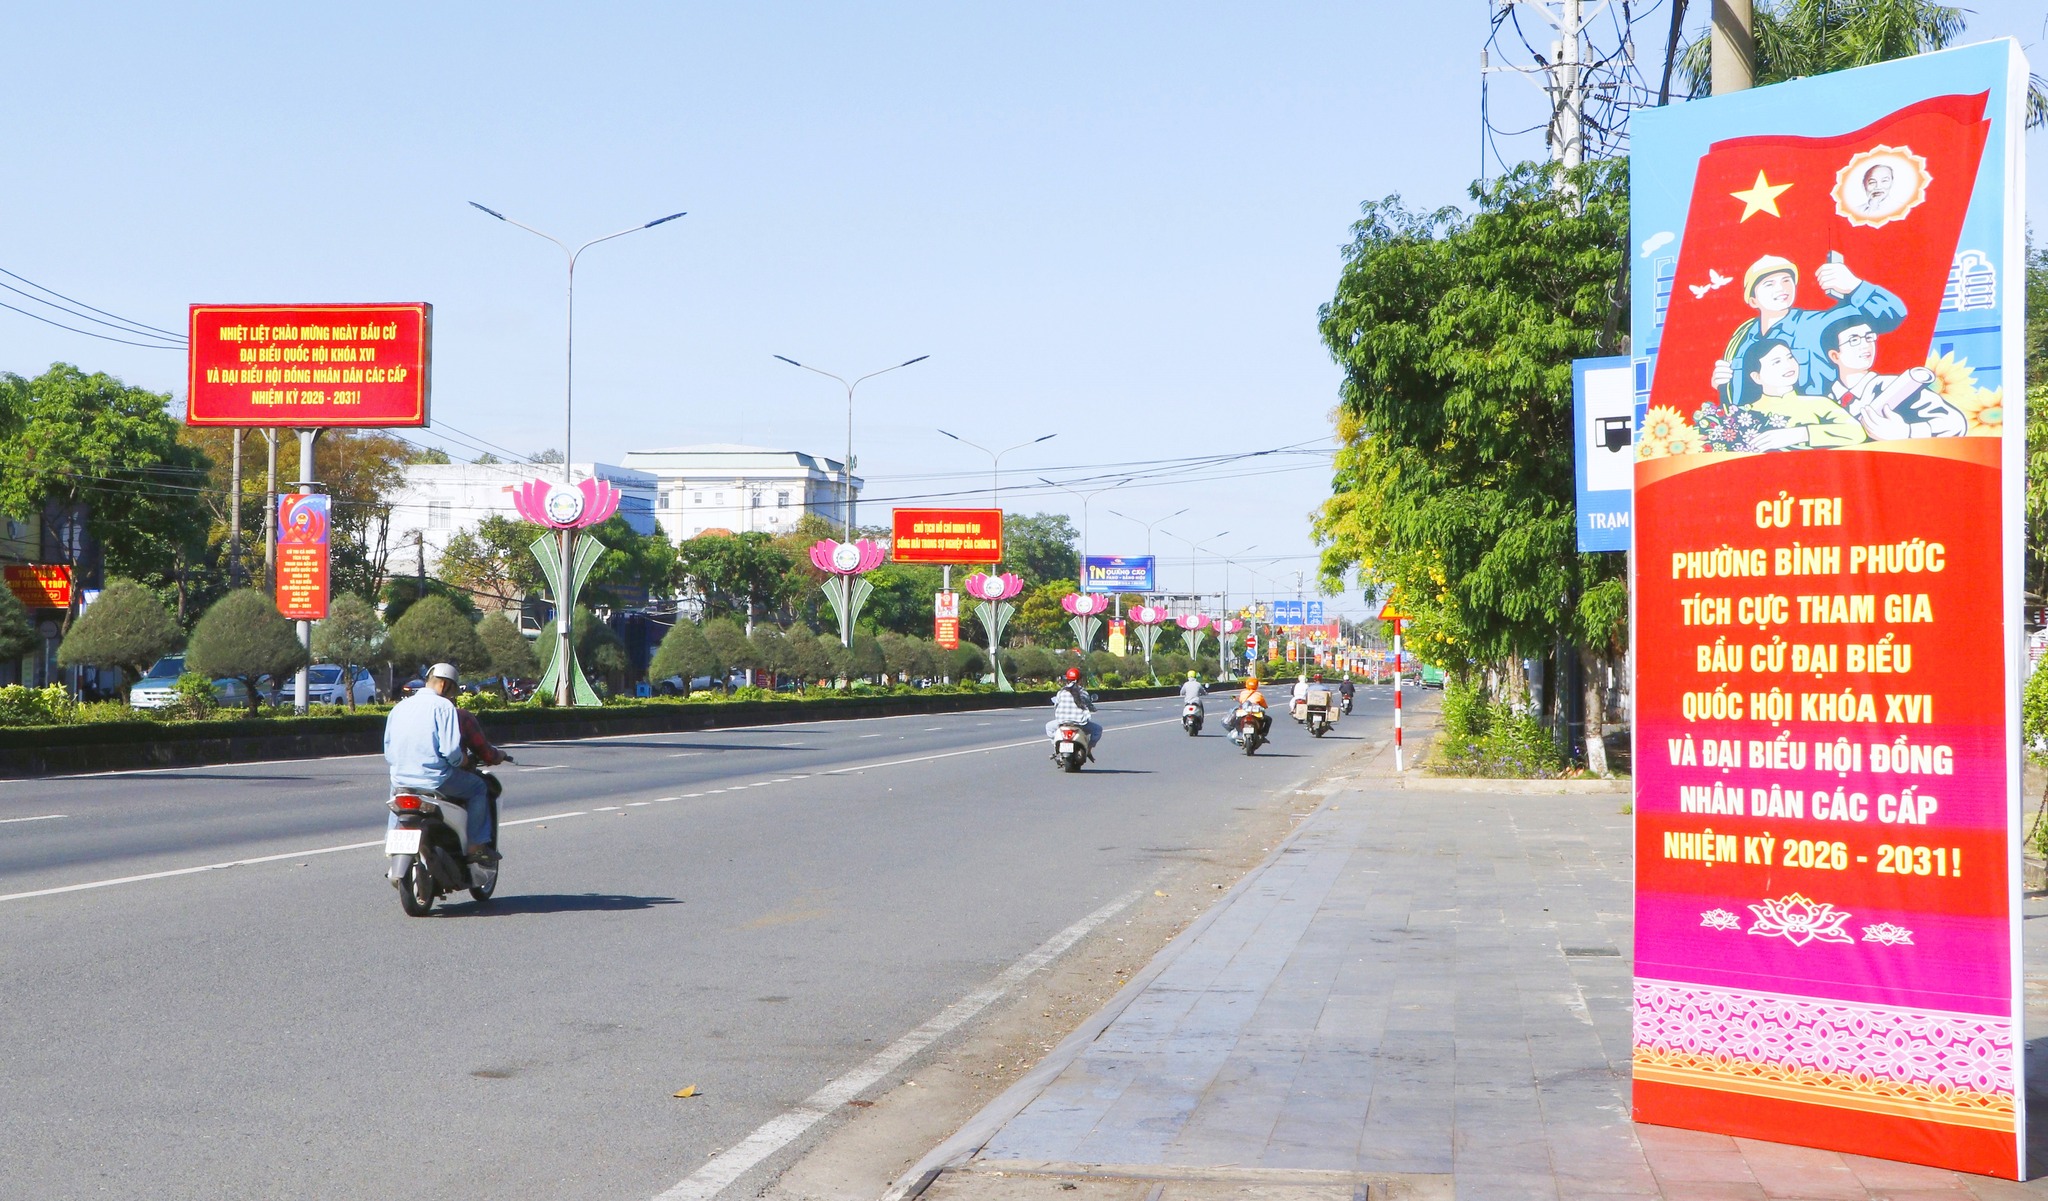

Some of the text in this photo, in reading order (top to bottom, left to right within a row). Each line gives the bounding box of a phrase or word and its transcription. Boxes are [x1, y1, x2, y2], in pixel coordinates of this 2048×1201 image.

[220, 322, 397, 343] NHIỆT LIỆT CHÀO MỪNG NGÀY BẦU CỬ
[240, 343, 375, 364] ĐẠI BIỂU QUỐC HỘI KHÓA XVI
[207, 364, 407, 386] VÀ ĐẠI BIỂU HỘI ĐỒNG NHÂN DÂN CÁC CẤP
[252, 389, 283, 407] NHIỆM
[286, 388, 299, 404] KỲ
[301, 391, 324, 404] 2026
[333, 391, 360, 404] 2031!
[1588, 511, 1629, 530] TRẠM
[1756, 491, 1842, 528] CỬ TRI
[1673, 538, 1945, 579] PHƯỜNG BÌNH PHƯỚC
[1681, 593, 1933, 630] TÍCH CỰC THAM GIA
[1697, 633, 1911, 678] BẦU CỬ ĐẠI BIỂU
[1683, 683, 1932, 727] QUỐC HỘI KHÓA XVI
[1668, 730, 1953, 777] VÀ ĐẠI BIỂU HỘI ĐỒNG
[1681, 781, 1937, 824] NHÂN DÂN CÁC CẤP
[1664, 828, 1737, 867] NHIỆM
[1745, 832, 1775, 865] KỲ
[1783, 839, 1848, 870] 2026
[1877, 844, 1960, 877] 2031!
